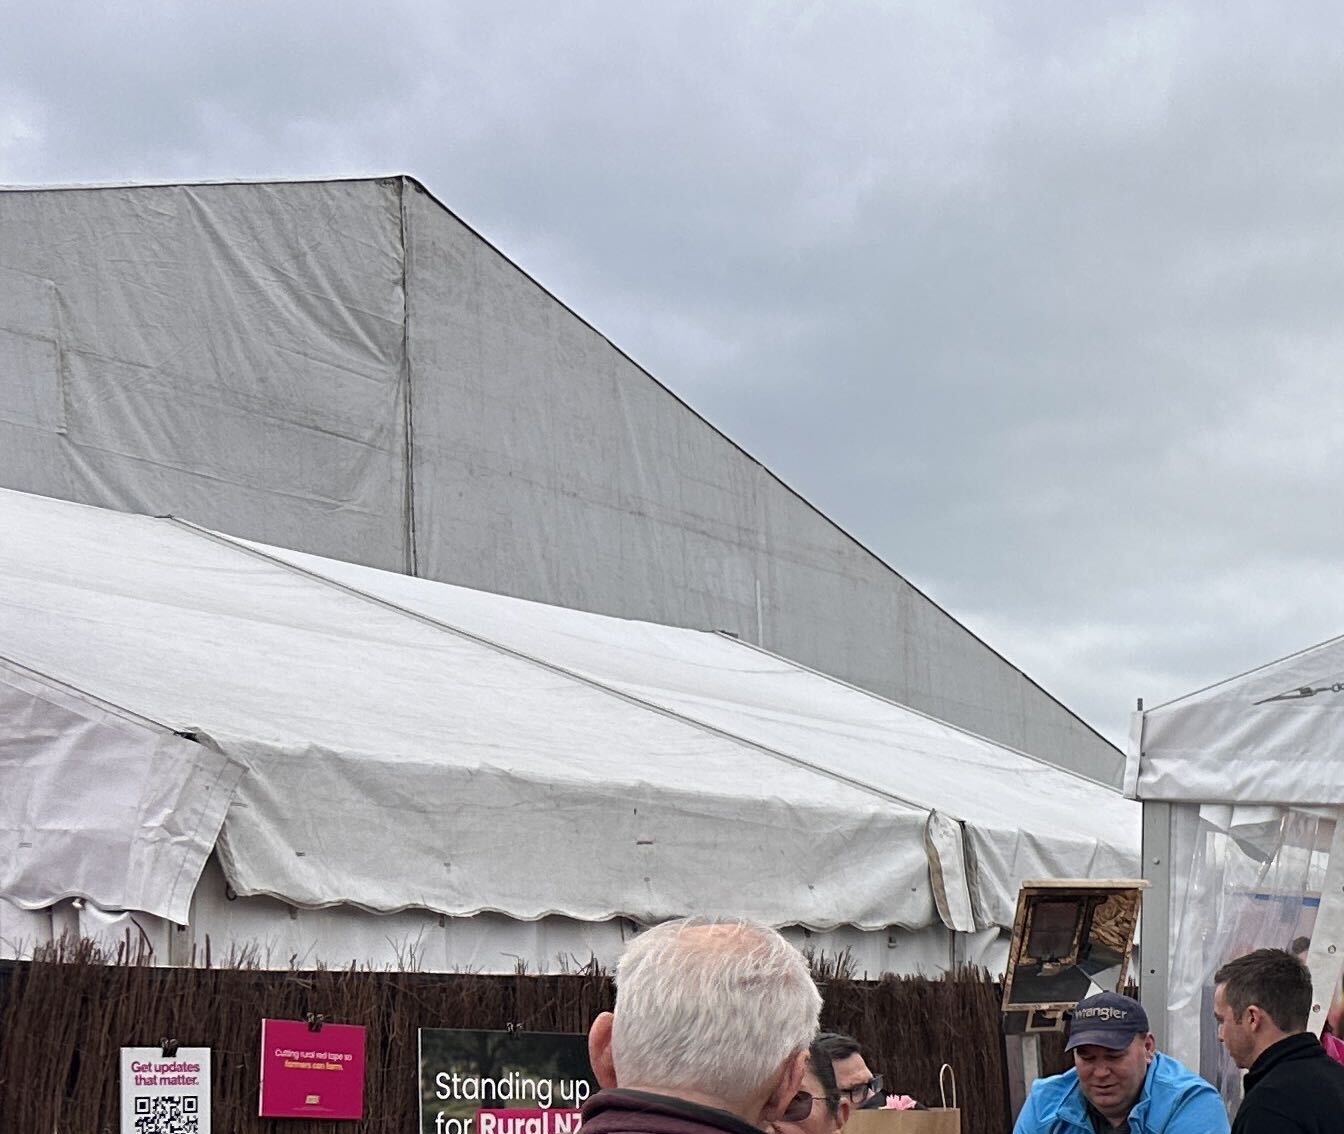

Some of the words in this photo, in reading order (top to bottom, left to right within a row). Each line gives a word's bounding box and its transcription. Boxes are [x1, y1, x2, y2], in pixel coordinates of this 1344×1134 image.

[130, 1061, 153, 1073] Get
[153, 1061, 201, 1075] updates
[134, 1074, 158, 1086] that
[159, 1074, 200, 1086] matter.
[435, 1071, 553, 1110] Standing
[560, 1079, 591, 1109] up
